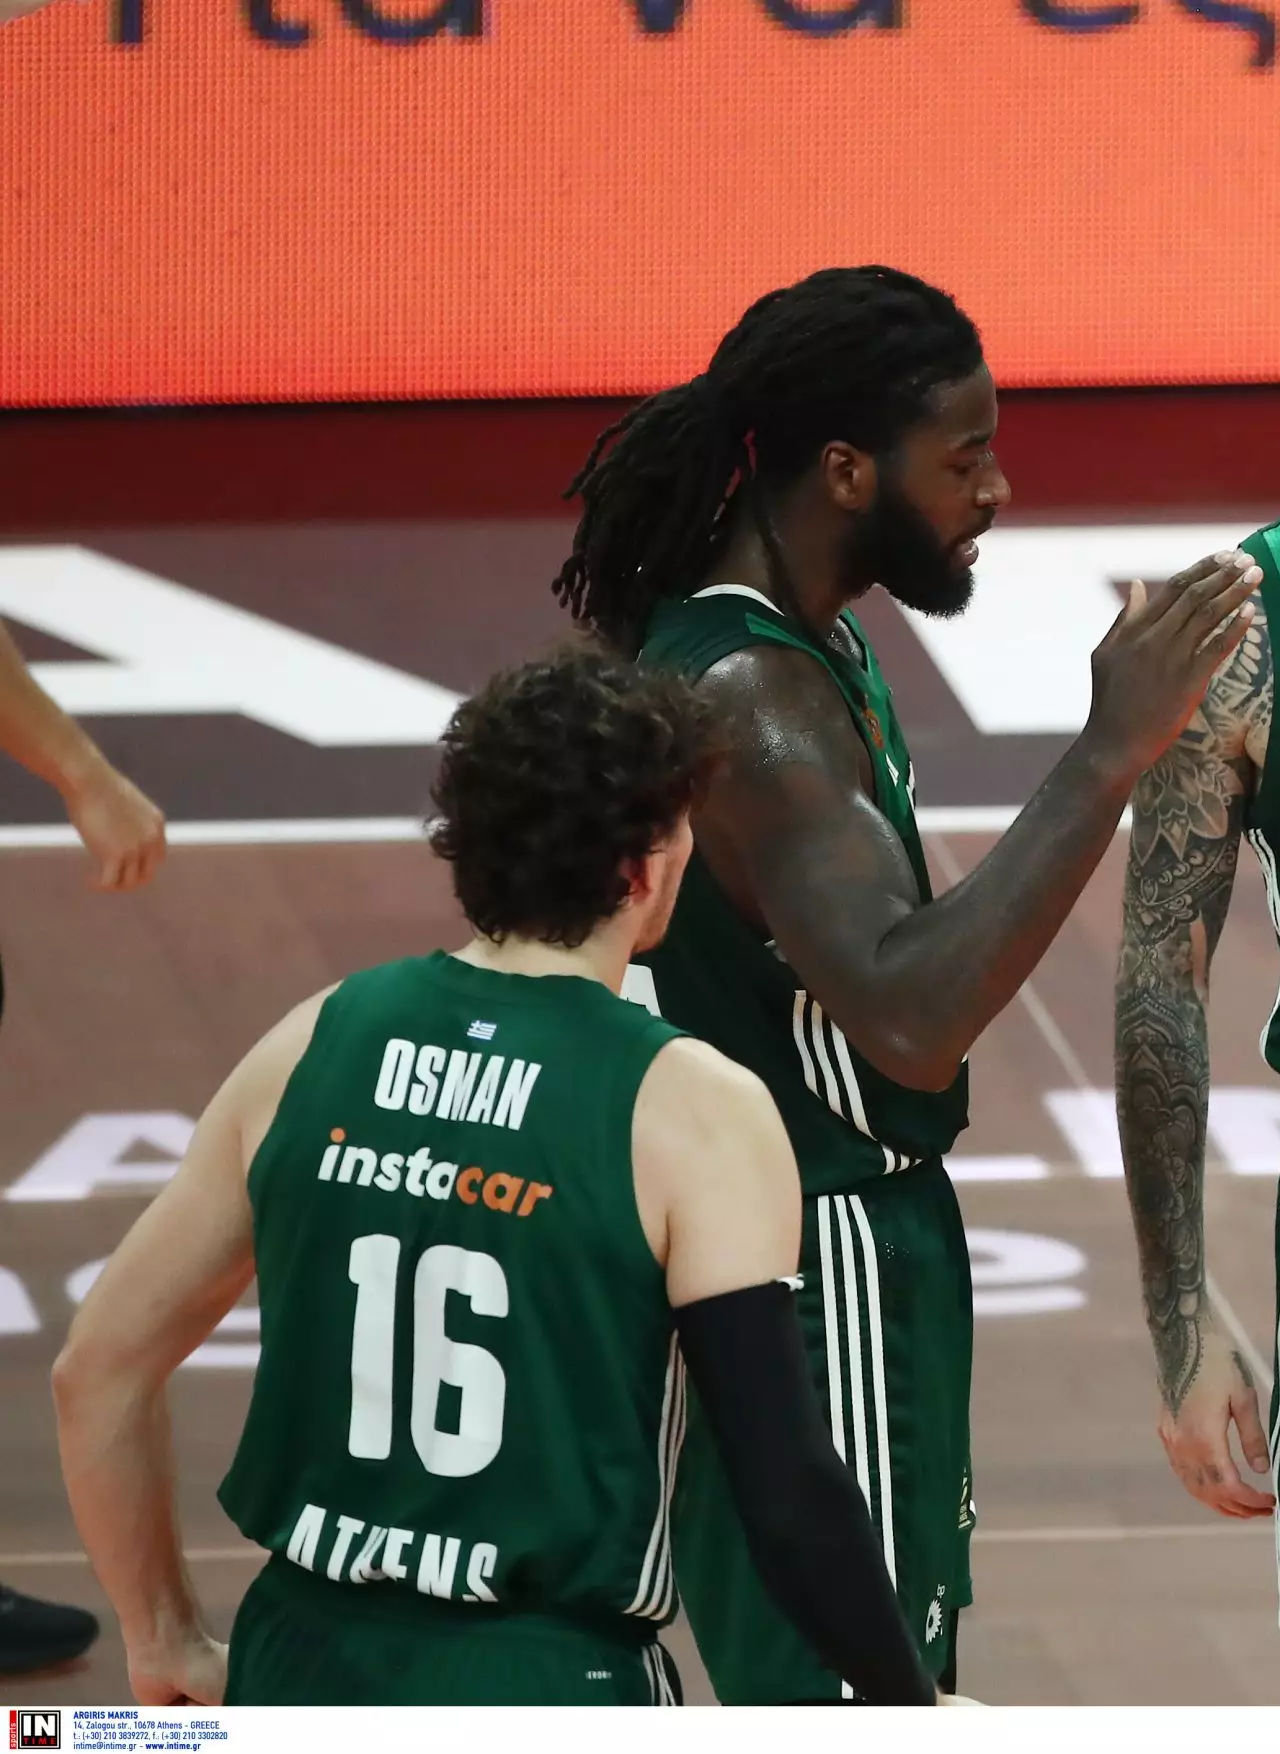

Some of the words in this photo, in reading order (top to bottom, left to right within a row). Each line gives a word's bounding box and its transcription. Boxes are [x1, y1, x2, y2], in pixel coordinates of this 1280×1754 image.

[374, 1038, 542, 1131] OSMAN
[318, 1127, 553, 1217] instacar
[348, 1234, 509, 1477] 16
